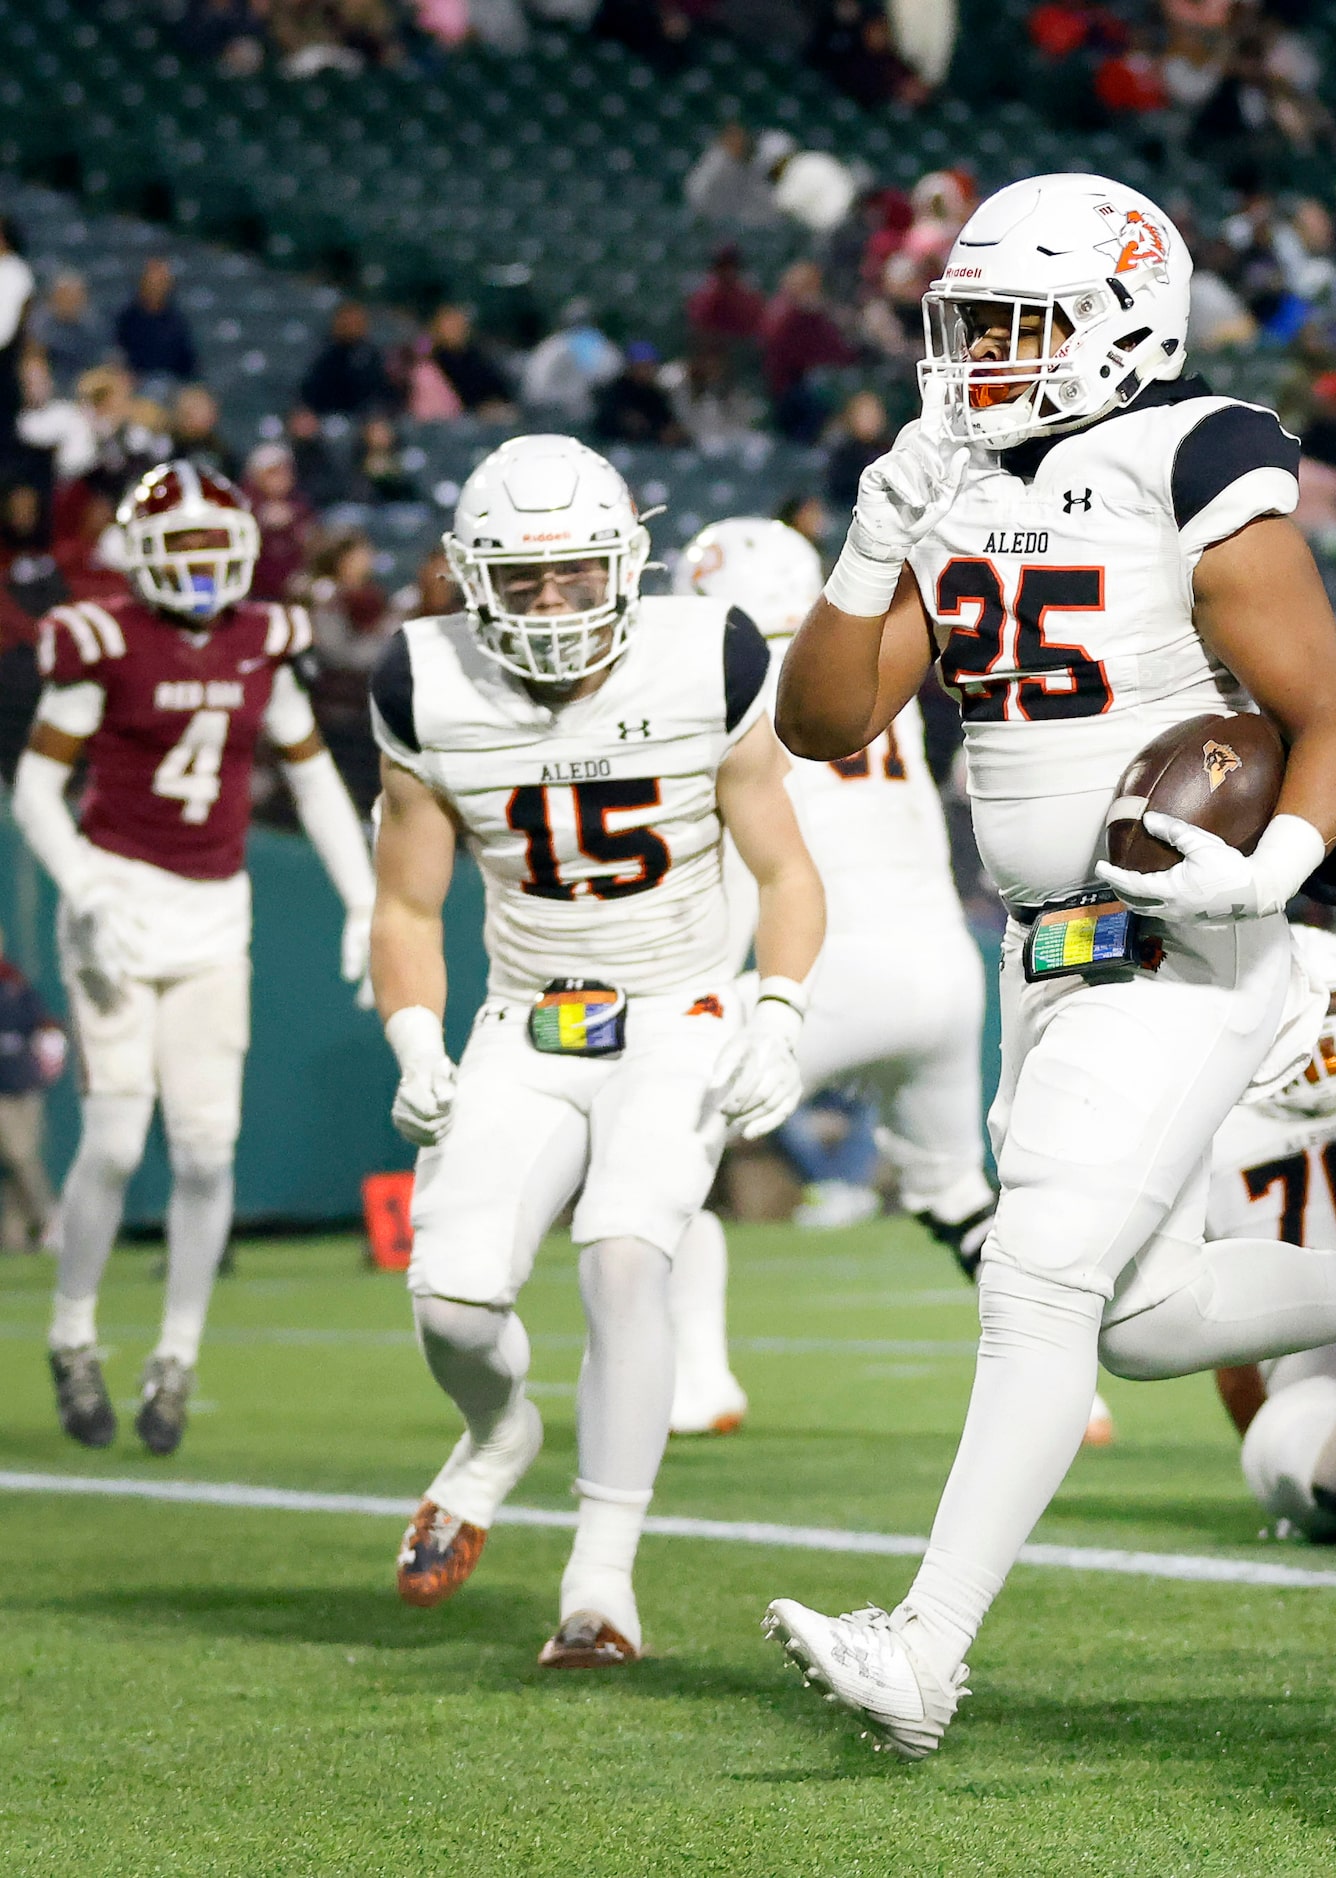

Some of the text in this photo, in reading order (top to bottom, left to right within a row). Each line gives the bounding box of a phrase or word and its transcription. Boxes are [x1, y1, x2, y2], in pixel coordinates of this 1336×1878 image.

[946, 267, 982, 278] Riddell
[522, 532, 573, 543] Riddell
[983, 532, 1049, 554] ALEDO
[936, 557, 1115, 721] 25
[153, 711, 230, 826] 4
[541, 759, 611, 781] ALEDO
[505, 776, 672, 902] 15
